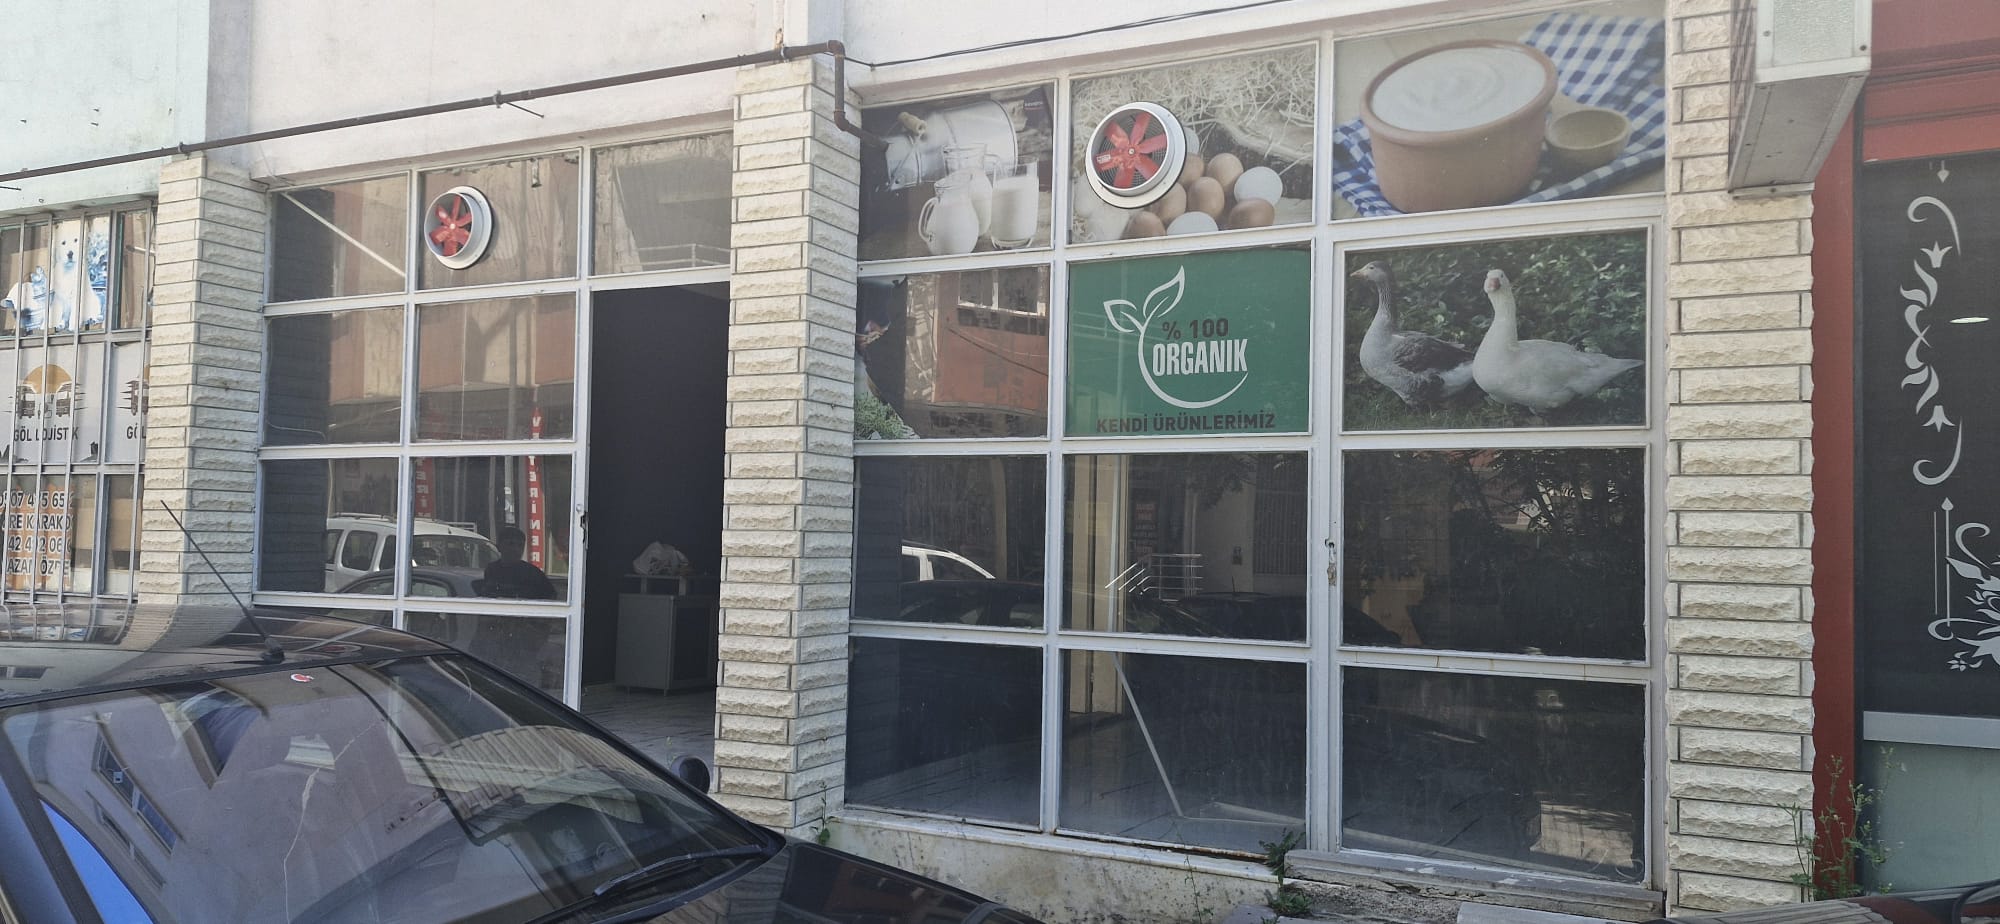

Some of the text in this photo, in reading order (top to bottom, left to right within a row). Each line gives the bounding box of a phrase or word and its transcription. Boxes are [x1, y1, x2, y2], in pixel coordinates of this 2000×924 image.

[1162, 318, 1229, 340] % 100
[1152, 338, 1249, 377] ORGANIK
[1096, 410, 1276, 433] KENDİ ÜRÜNLERİMİZ
[14, 425, 79, 441] GÖL LOJİSTK
[27, 492, 48, 508] 45
[25, 537, 47, 552] 42
